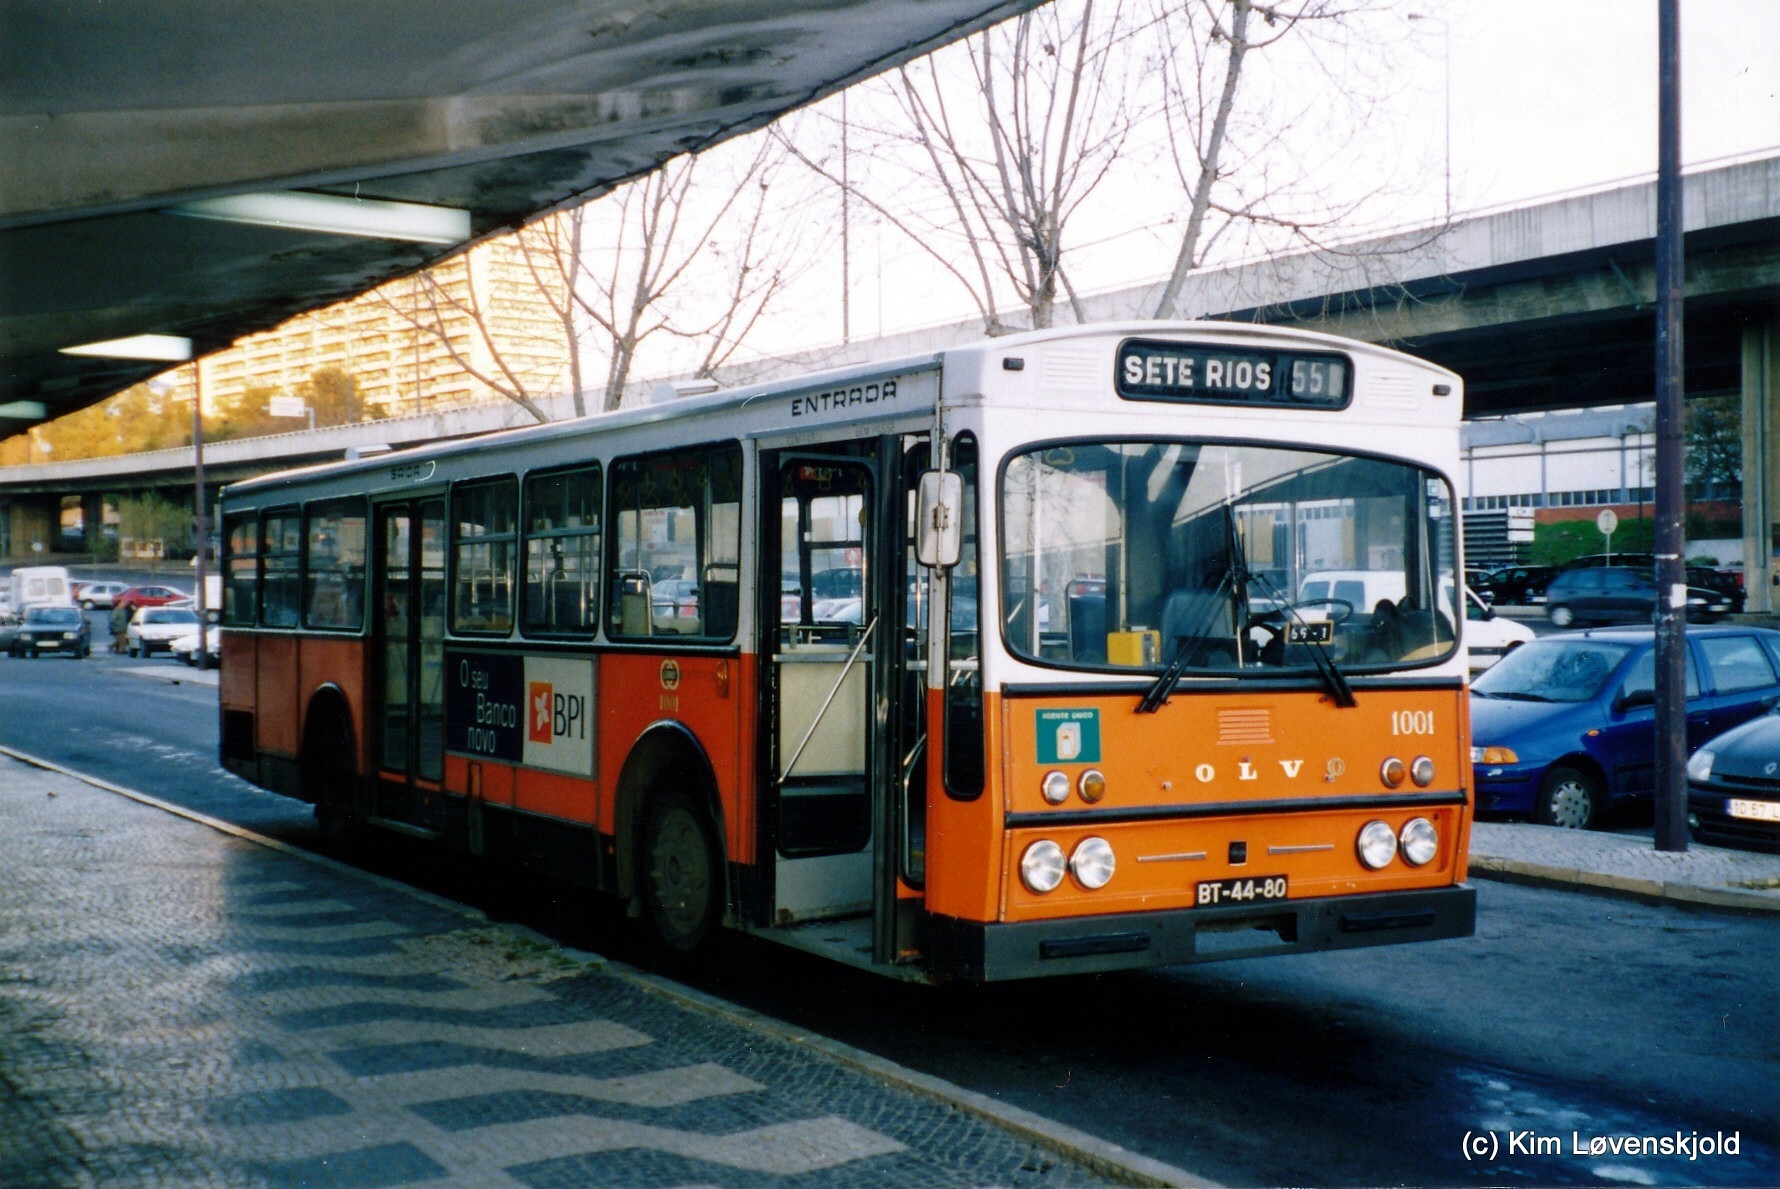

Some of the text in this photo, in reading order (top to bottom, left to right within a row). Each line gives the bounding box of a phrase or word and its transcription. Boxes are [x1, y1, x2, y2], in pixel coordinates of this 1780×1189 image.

[1125, 355, 1194, 386] SETE
[1205, 359, 1271, 391] RIOS
[791, 380, 897, 417] ENTRADA
[460, 658, 489, 690] O seu
[477, 693, 517, 729] Banco
[553, 693, 585, 740] BPI
[1391, 710, 1435, 736] 1001
[467, 727, 497, 753] novo
[1198, 878, 1287, 905] BT-44-80
